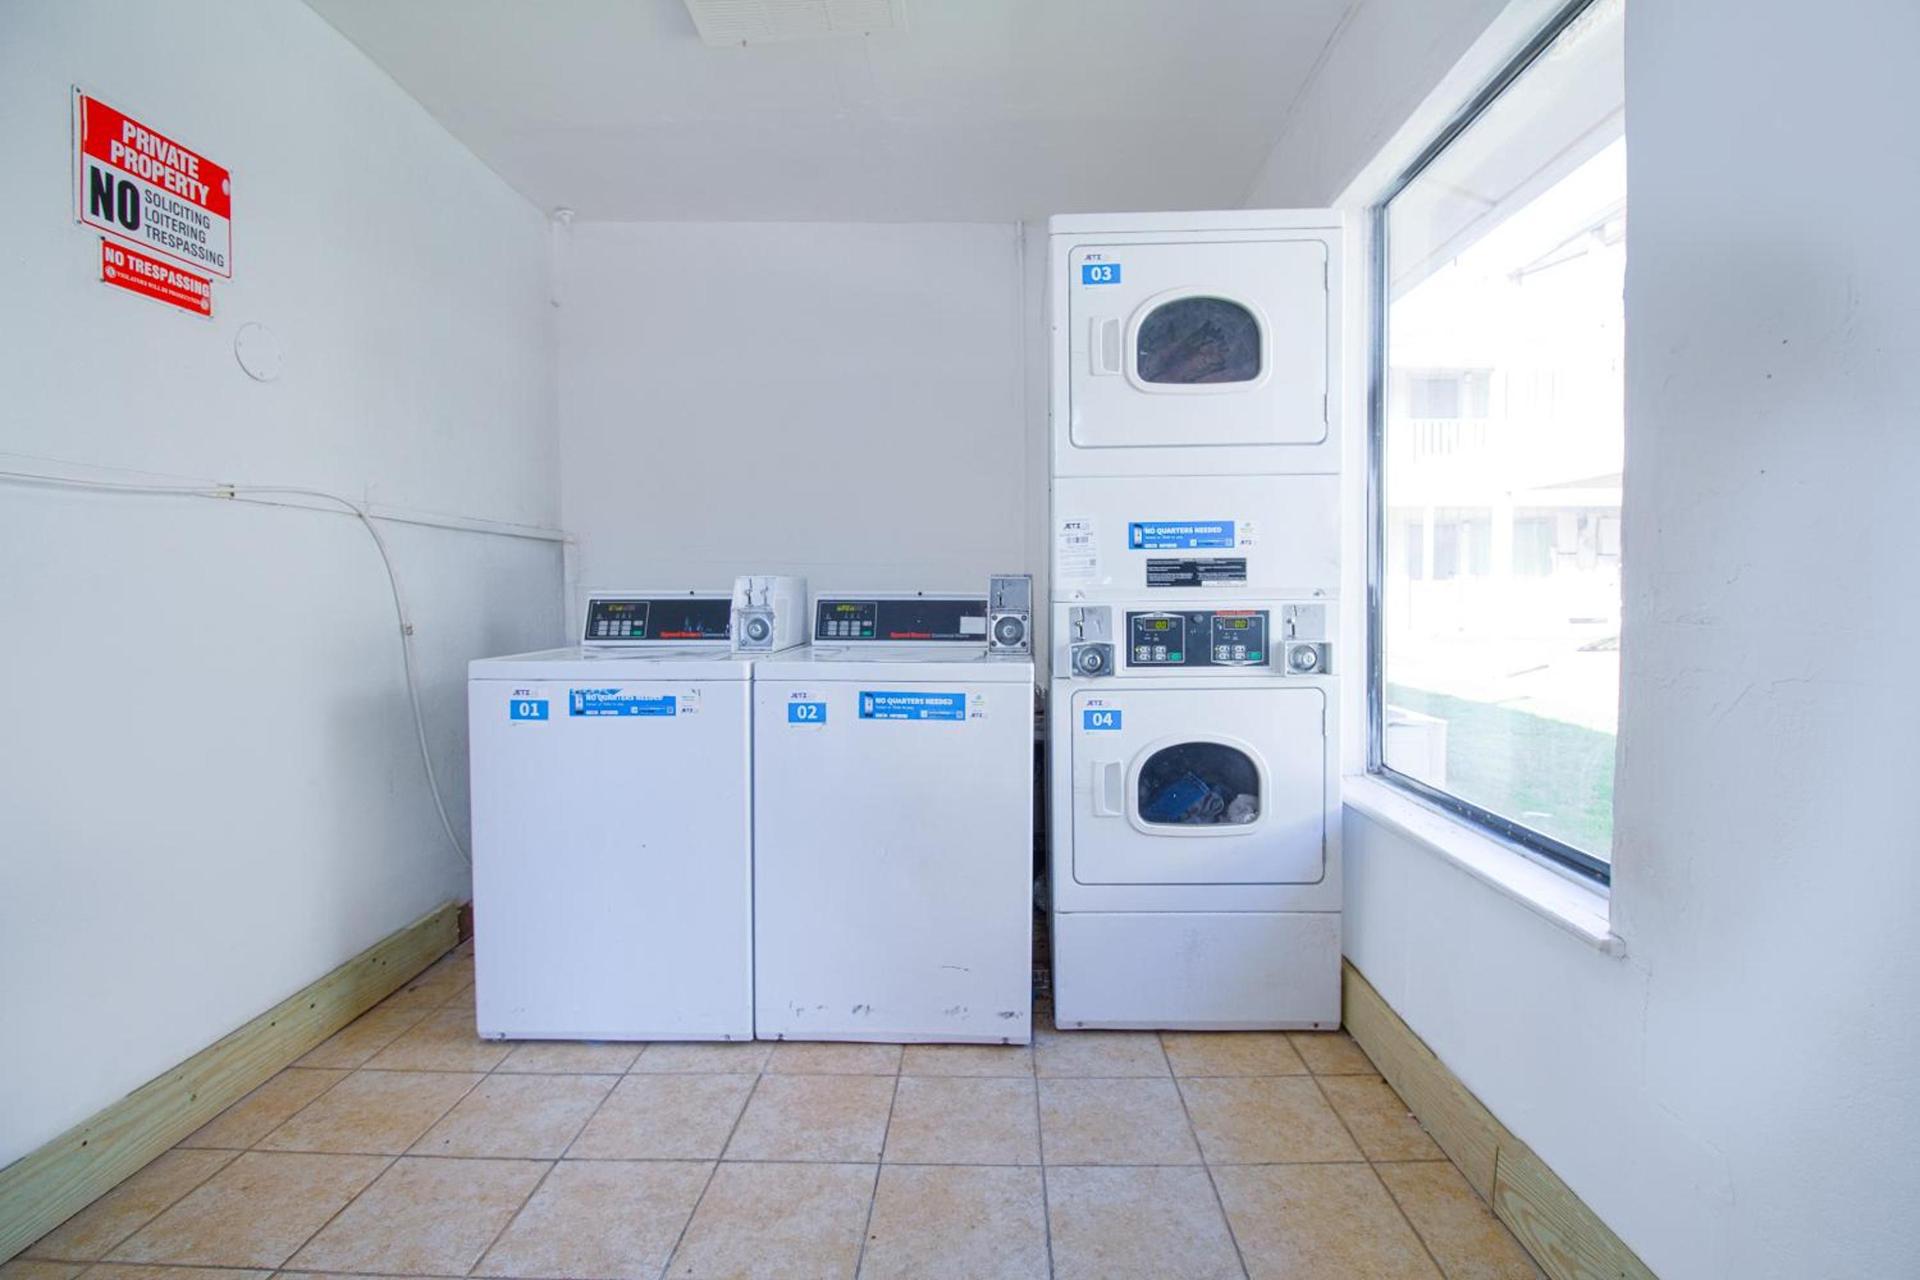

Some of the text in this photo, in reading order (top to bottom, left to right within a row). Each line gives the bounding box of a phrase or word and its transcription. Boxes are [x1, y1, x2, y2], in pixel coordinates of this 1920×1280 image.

[122, 120, 200, 180] PRIVATE
[111, 139, 210, 206] PROPERTY
[90, 165, 141, 231] NO
[145, 189, 211, 230] SOLICITING
[145, 205, 206, 244] LOITERING
[145, 224, 225, 267] TRESPASSING
[105, 247, 210, 297] NO TRESPASSING
[1091, 266, 1112, 281] 03
[1156, 527, 1193, 536] QUARTERS
[1194, 526, 1222, 534] NEEDED
[518, 702, 541, 717] 01
[797, 705, 818, 719] 02
[887, 697, 924, 706] QUARTERS
[1093, 712, 1113, 727] 04
